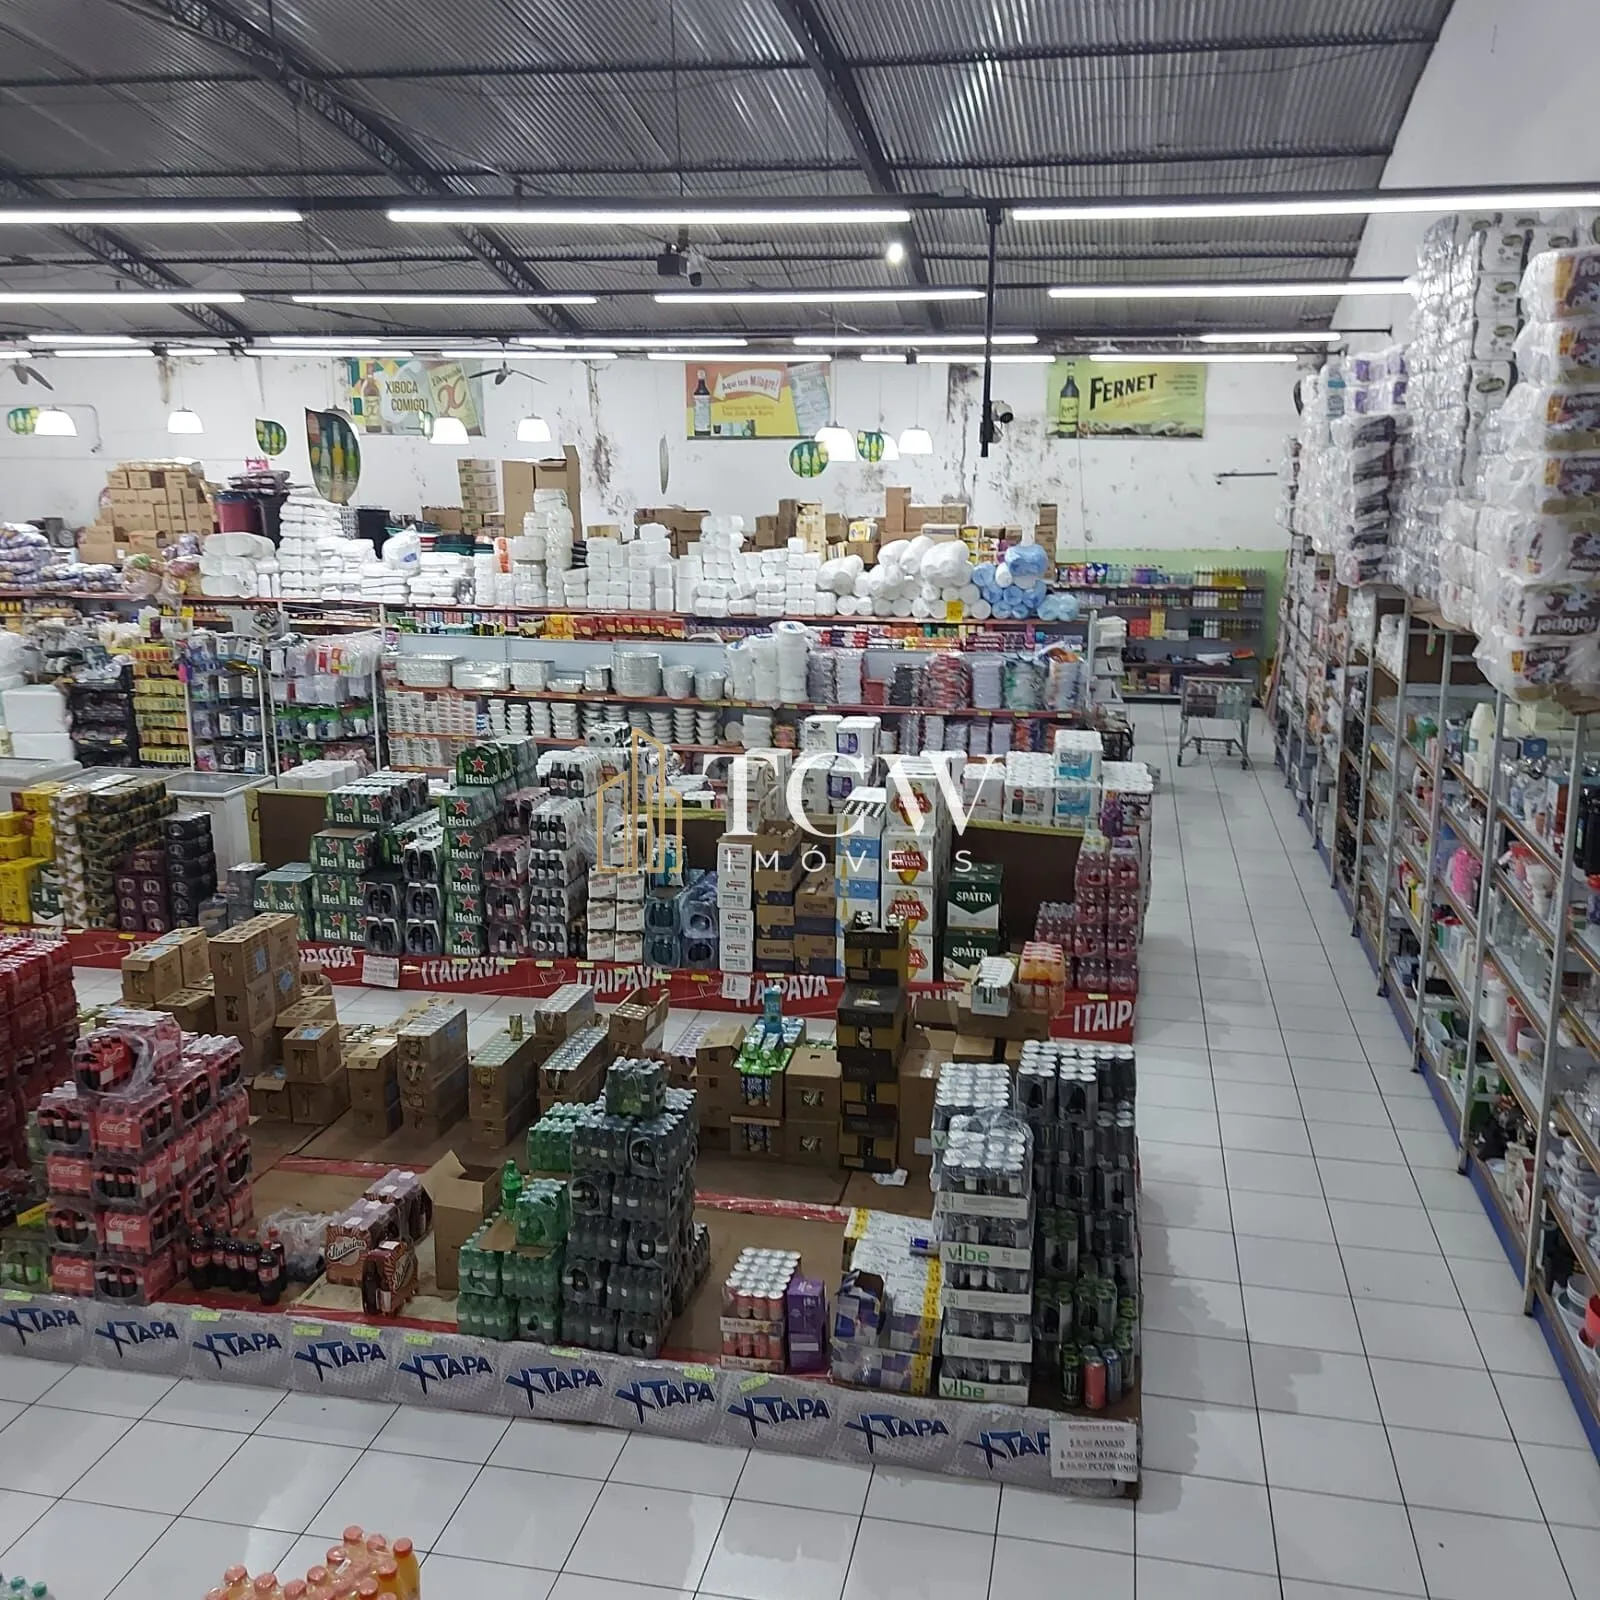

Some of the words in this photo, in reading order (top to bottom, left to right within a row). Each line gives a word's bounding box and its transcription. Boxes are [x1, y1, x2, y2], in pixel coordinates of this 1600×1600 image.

[385, 381, 418, 394] XIBOCA
[391, 399, 429, 411] COMIGO!
[1089, 373, 1158, 410] FERNET
[956, 891, 992, 903] SPATEN
[421, 957, 510, 985] ITAIPAVA
[952, 947, 988, 959] SPATEN
[576, 966, 667, 994] ITAIPAVA
[1073, 1000, 1135, 1033] ITAIP
[95, 1319, 179, 1358] XTAPA
[192, 1332, 282, 1369] XTAPA
[294, 1341, 387, 1382] XTAPA
[398, 1352, 494, 1395] XTAPA
[505, 1367, 604, 1410] XTAPA
[615, 1380, 716, 1425] XTAPA
[727, 1396, 833, 1441] XTAPA
[845, 1413, 949, 1455] XTAPA
[964, 1430, 1050, 1471] XTAP
[1098, 1451, 1136, 1460] ATACADO
